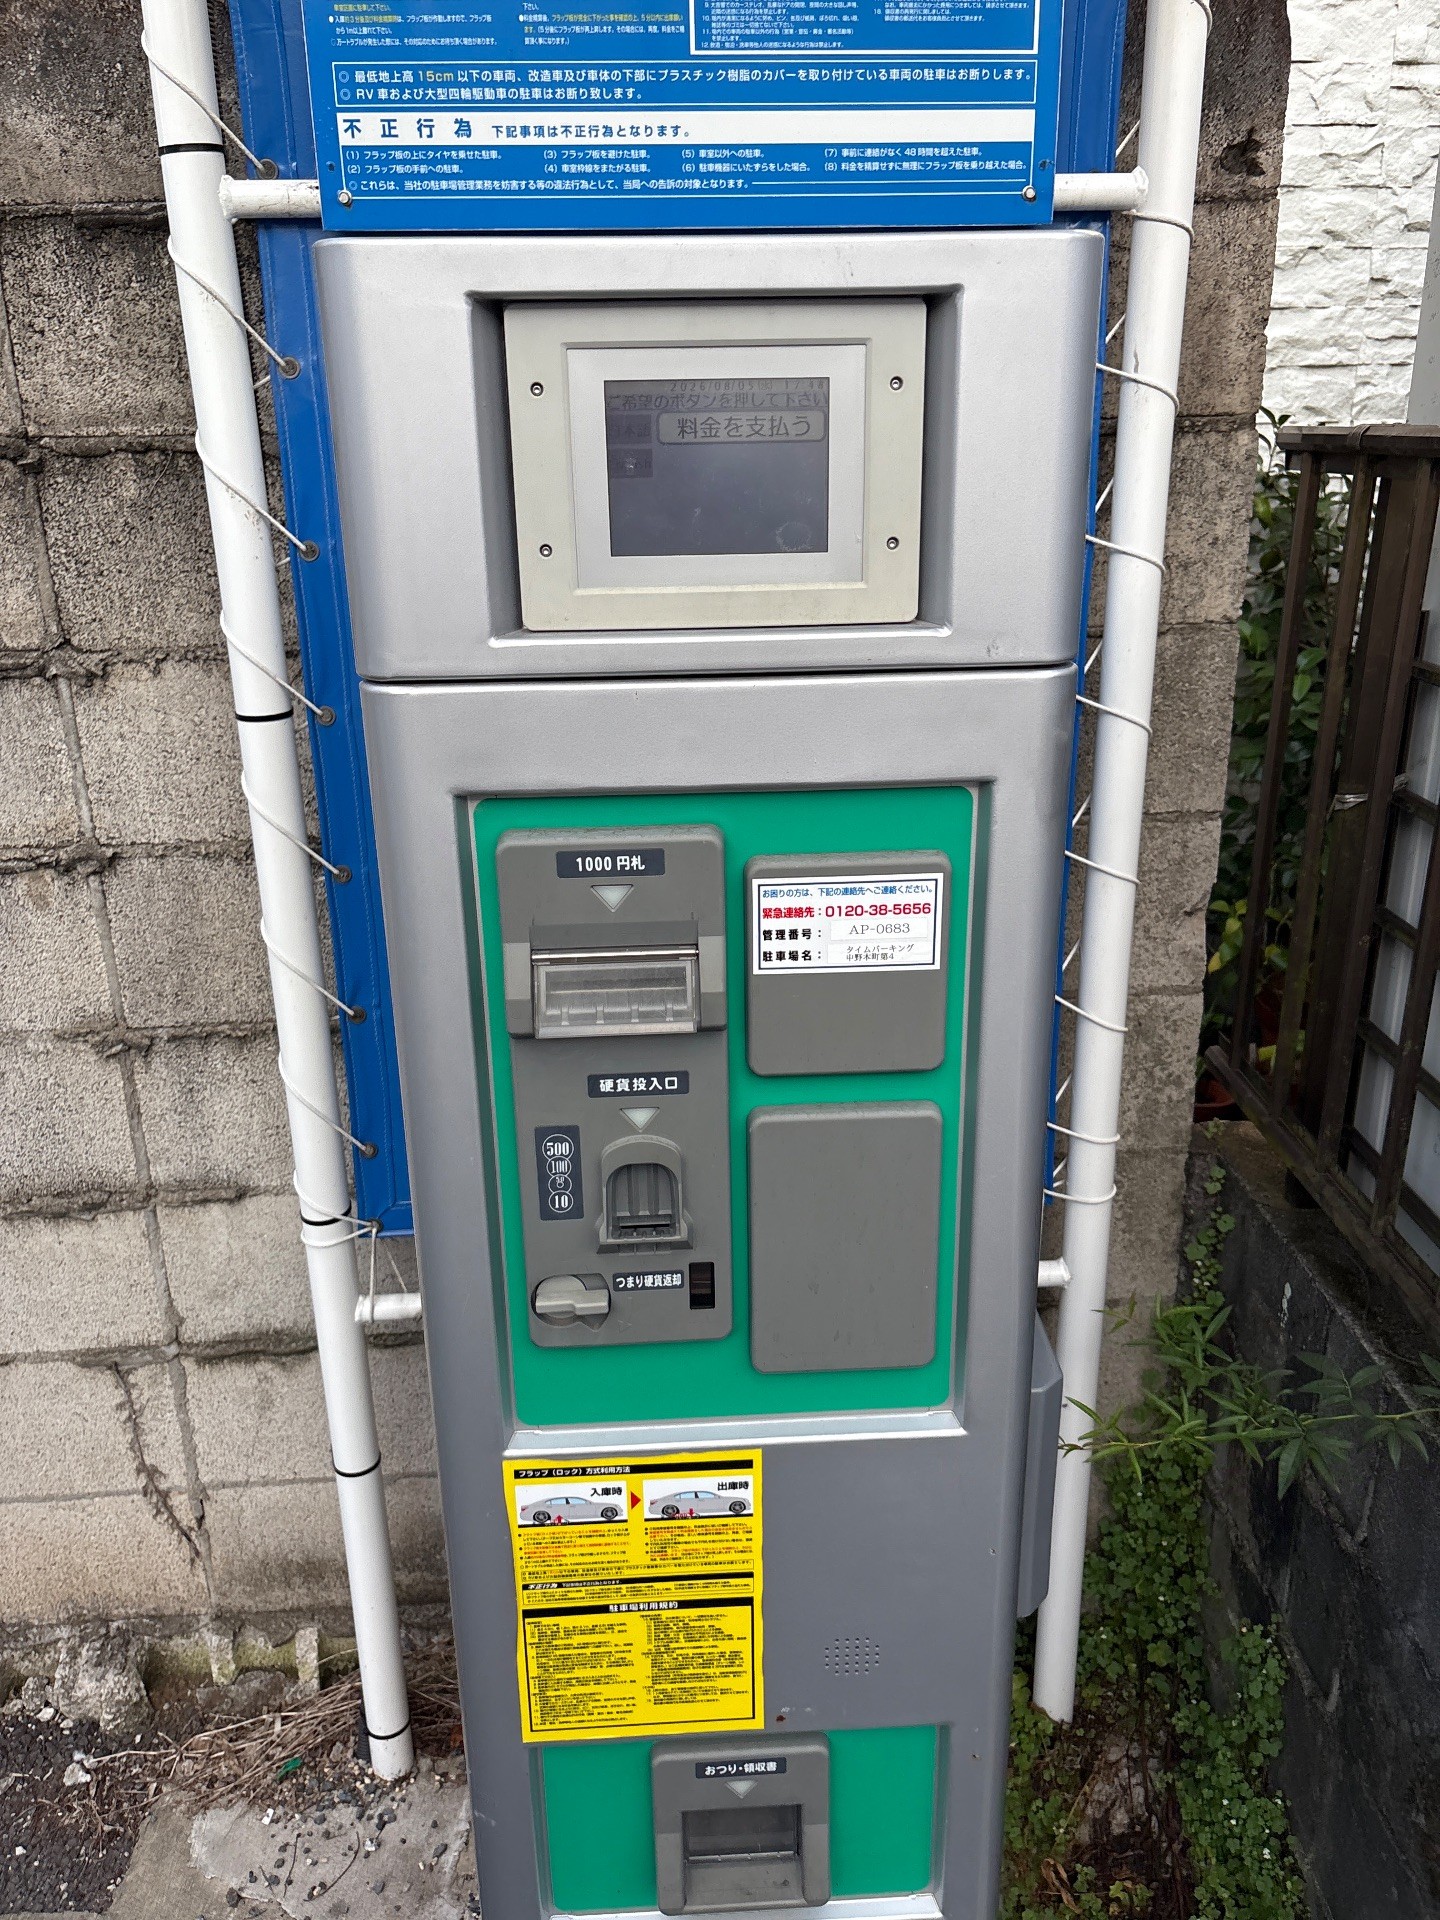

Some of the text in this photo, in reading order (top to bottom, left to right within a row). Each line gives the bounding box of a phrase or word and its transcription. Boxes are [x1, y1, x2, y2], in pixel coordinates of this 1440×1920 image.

[354, 71, 414, 83] 最低地上高
[419, 71, 454, 82] 15cm
[343, 118, 690, 140] 不正行為 下記事項は不正行為となります。
[363, 150, 502, 160] フラップ板の上にタイヤを乗せた駐車。
[365, 164, 464, 174] フラップ板の手前への駐車。
[677, 415, 812, 440] 料金を支払う
[762, 884, 933, 899] お困りの方は、下記の連絡先へご連絡ください。
[825, 902, 932, 918] 0120-38-5656
[848, 922, 911, 935] AP-0683
[599, 1076, 678, 1093] 硬貨投入口
[546, 1141, 570, 1156] 500
[550, 1160, 568, 1174] 100
[554, 1194, 569, 1209] 10
[615, 1273, 682, 1288] つまり硬貨返却
[590, 1486, 623, 1497] 入庫時
[717, 1480, 749, 1491] 出庫時
[608, 1600, 679, 1613] 駐車場利用規約
[704, 1760, 778, 1776] おつり・領収書
